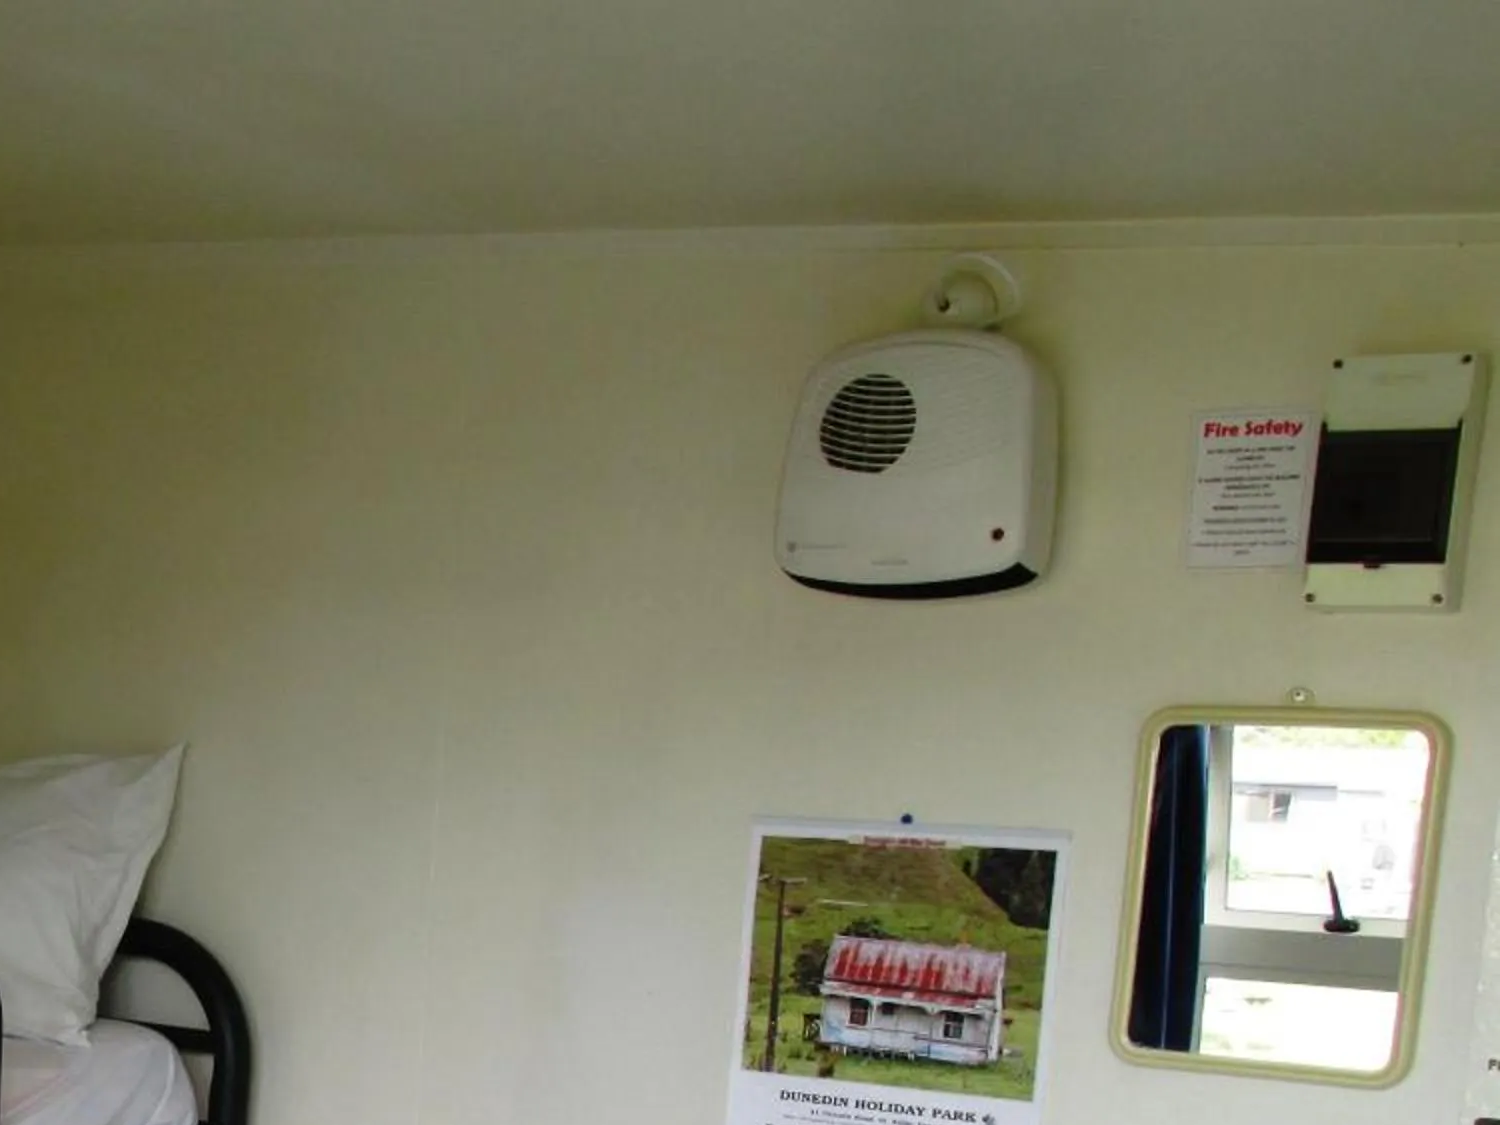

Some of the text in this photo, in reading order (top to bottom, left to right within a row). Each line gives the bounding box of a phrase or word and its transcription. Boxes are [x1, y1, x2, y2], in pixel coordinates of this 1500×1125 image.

[1203, 419, 1303, 438] Fire Safety
[779, 1089, 849, 1108] DUNEDIN
[854, 1098, 926, 1117] HOLIDAY
[931, 1107, 977, 1123] PARK
